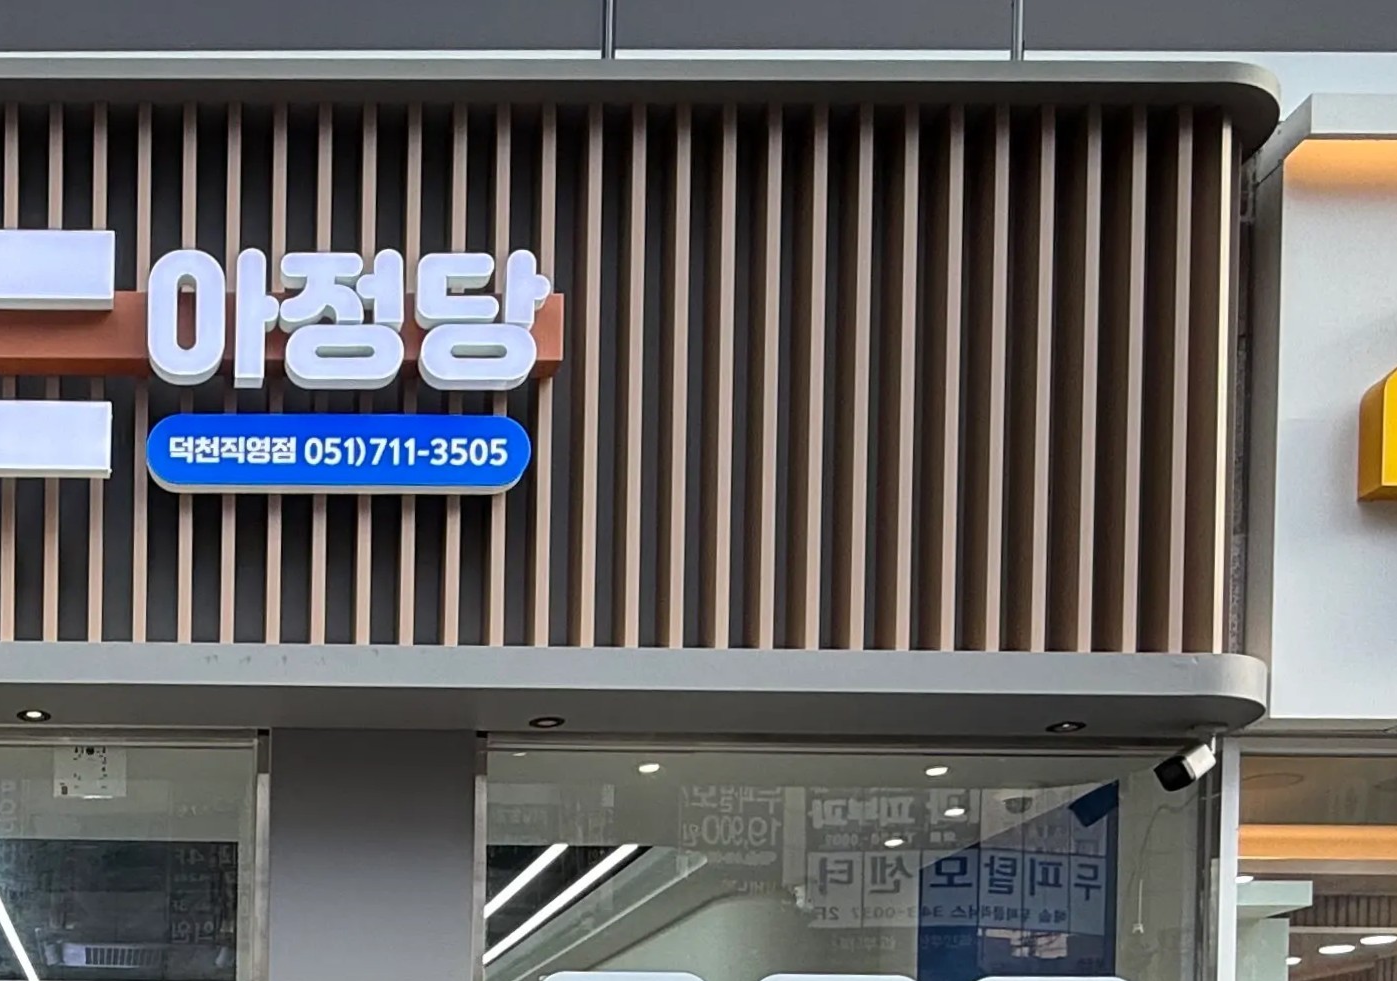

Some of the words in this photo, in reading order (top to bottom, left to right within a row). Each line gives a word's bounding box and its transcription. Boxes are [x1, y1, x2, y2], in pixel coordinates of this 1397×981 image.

[147, 247, 551, 390] 아정당
[169, 436, 297, 464] 덕천직영점
[305, 436, 509, 467] 051)711-3505
